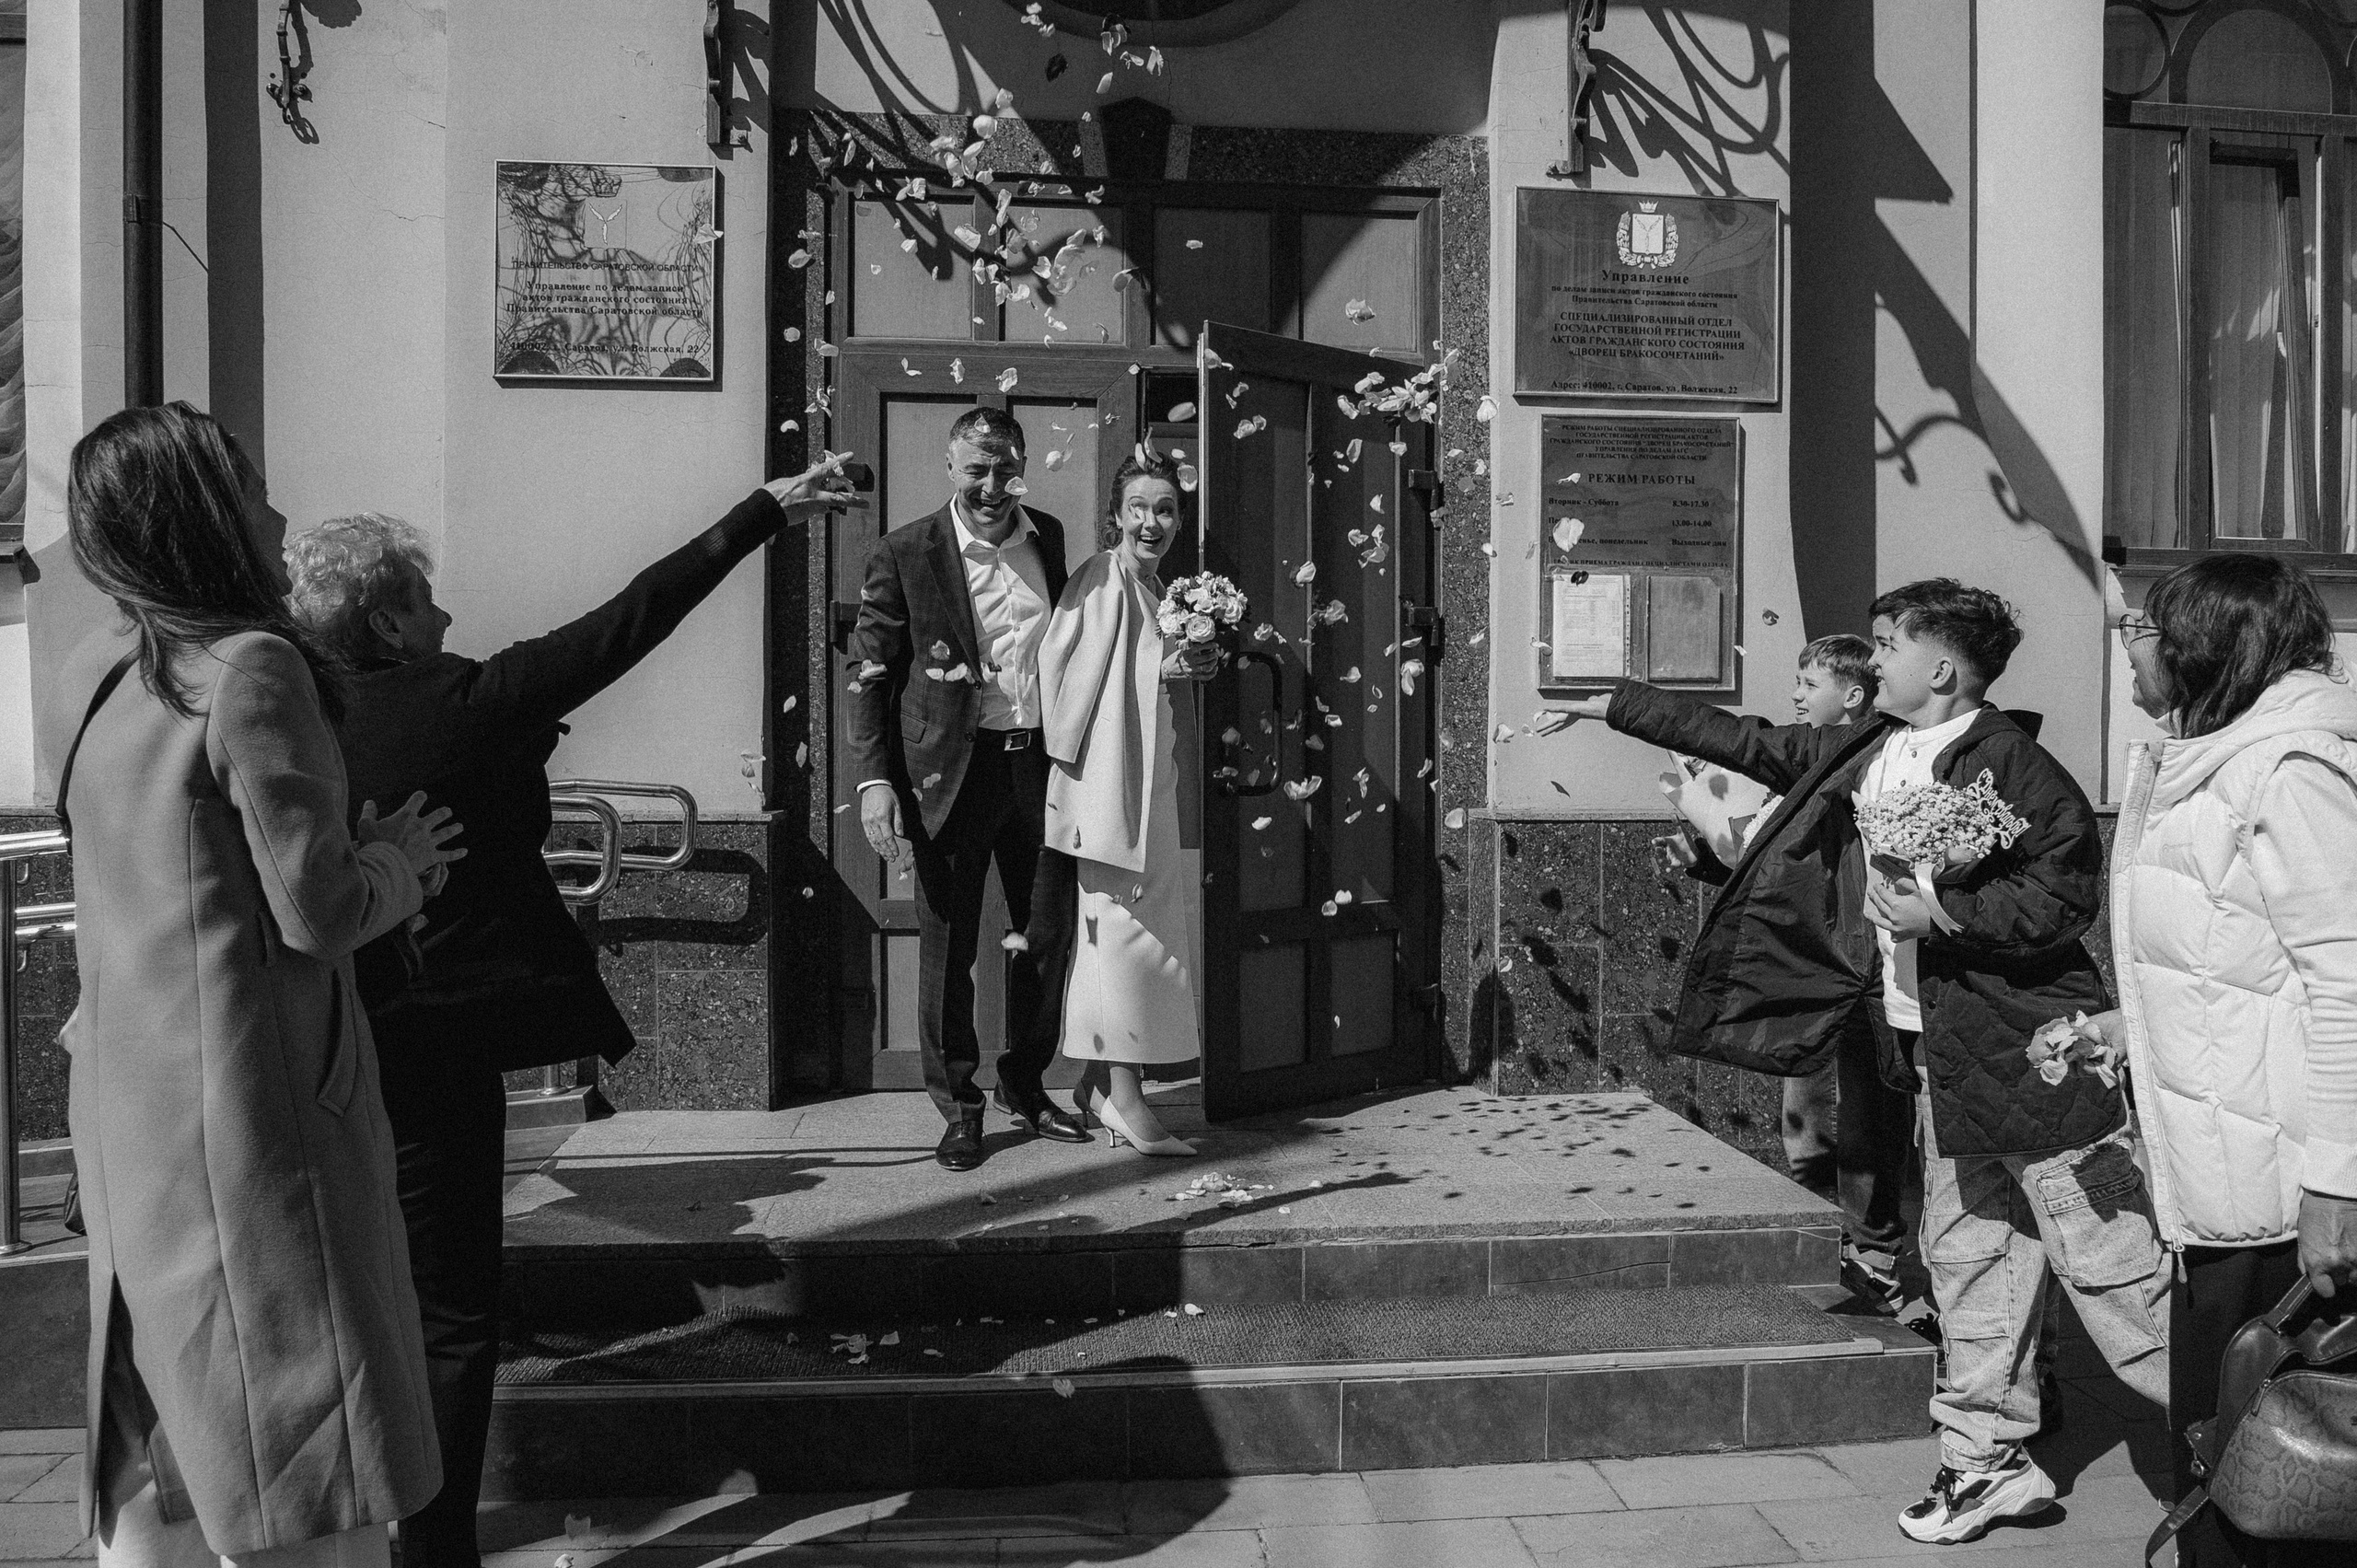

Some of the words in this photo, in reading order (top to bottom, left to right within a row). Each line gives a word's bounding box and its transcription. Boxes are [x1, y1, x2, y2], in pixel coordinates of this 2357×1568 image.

[512, 261, 587, 270] ПРАВИТЕЛЬСТВО
[591, 262, 655, 272] САРАТОВСКОЙ
[656, 263, 698, 273] ОБЛАСТИ
[1601, 269, 1689, 285] Управление
[527, 281, 591, 292] Управление
[611, 285, 644, 293] делам
[1642, 288, 1697, 297] гражданского
[1699, 291, 1737, 299] состояния
[555, 296, 630, 304] гражданского
[1572, 295, 1632, 304] Правительства
[1634, 297, 1685, 307] Саратовской
[1687, 299, 1718, 308] области
[506, 304, 586, 314] Правительства
[590, 306, 657, 316] Саратовской
[661, 308, 702, 317] области
[1560, 312, 1695, 326] СПЕЦИАЛИЗИРОВАННЫЙ
[1698, 318, 1733, 327] ОТДЕЛ
[1554, 323, 1662, 336] ГОСУДАРСТВЕННОЙ
[1665, 327, 1741, 339] РЕГИСТРАЦИИ
[565, 343, 608, 353] Саратов,
[611, 344, 627, 353] ул.
[632, 343, 683, 354] Волжская,
[1550, 335, 1586, 344] АКТОВ
[1589, 336, 1676, 348] ГРАЖДАНСКОГО
[1678, 340, 1745, 351] СОСТОЯНИЯ
[1568, 348, 1617, 358] «ДВОРЕЦ
[1620, 350, 1724, 361] БРАКОСОЧЕТАНИЙ»
[1551, 380, 1581, 390] Адрес:
[1624, 382, 1663, 392] Саратов,
[1680, 385, 1726, 394] Волжская,
[1728, 386, 1737, 394] 22
[1588, 473, 1637, 483] РЕЖИМ
[1642, 474, 1695, 484] РАБОТЫ
[1549, 498, 1581, 506] Вторник
[1588, 499, 1619, 507] Суббота
